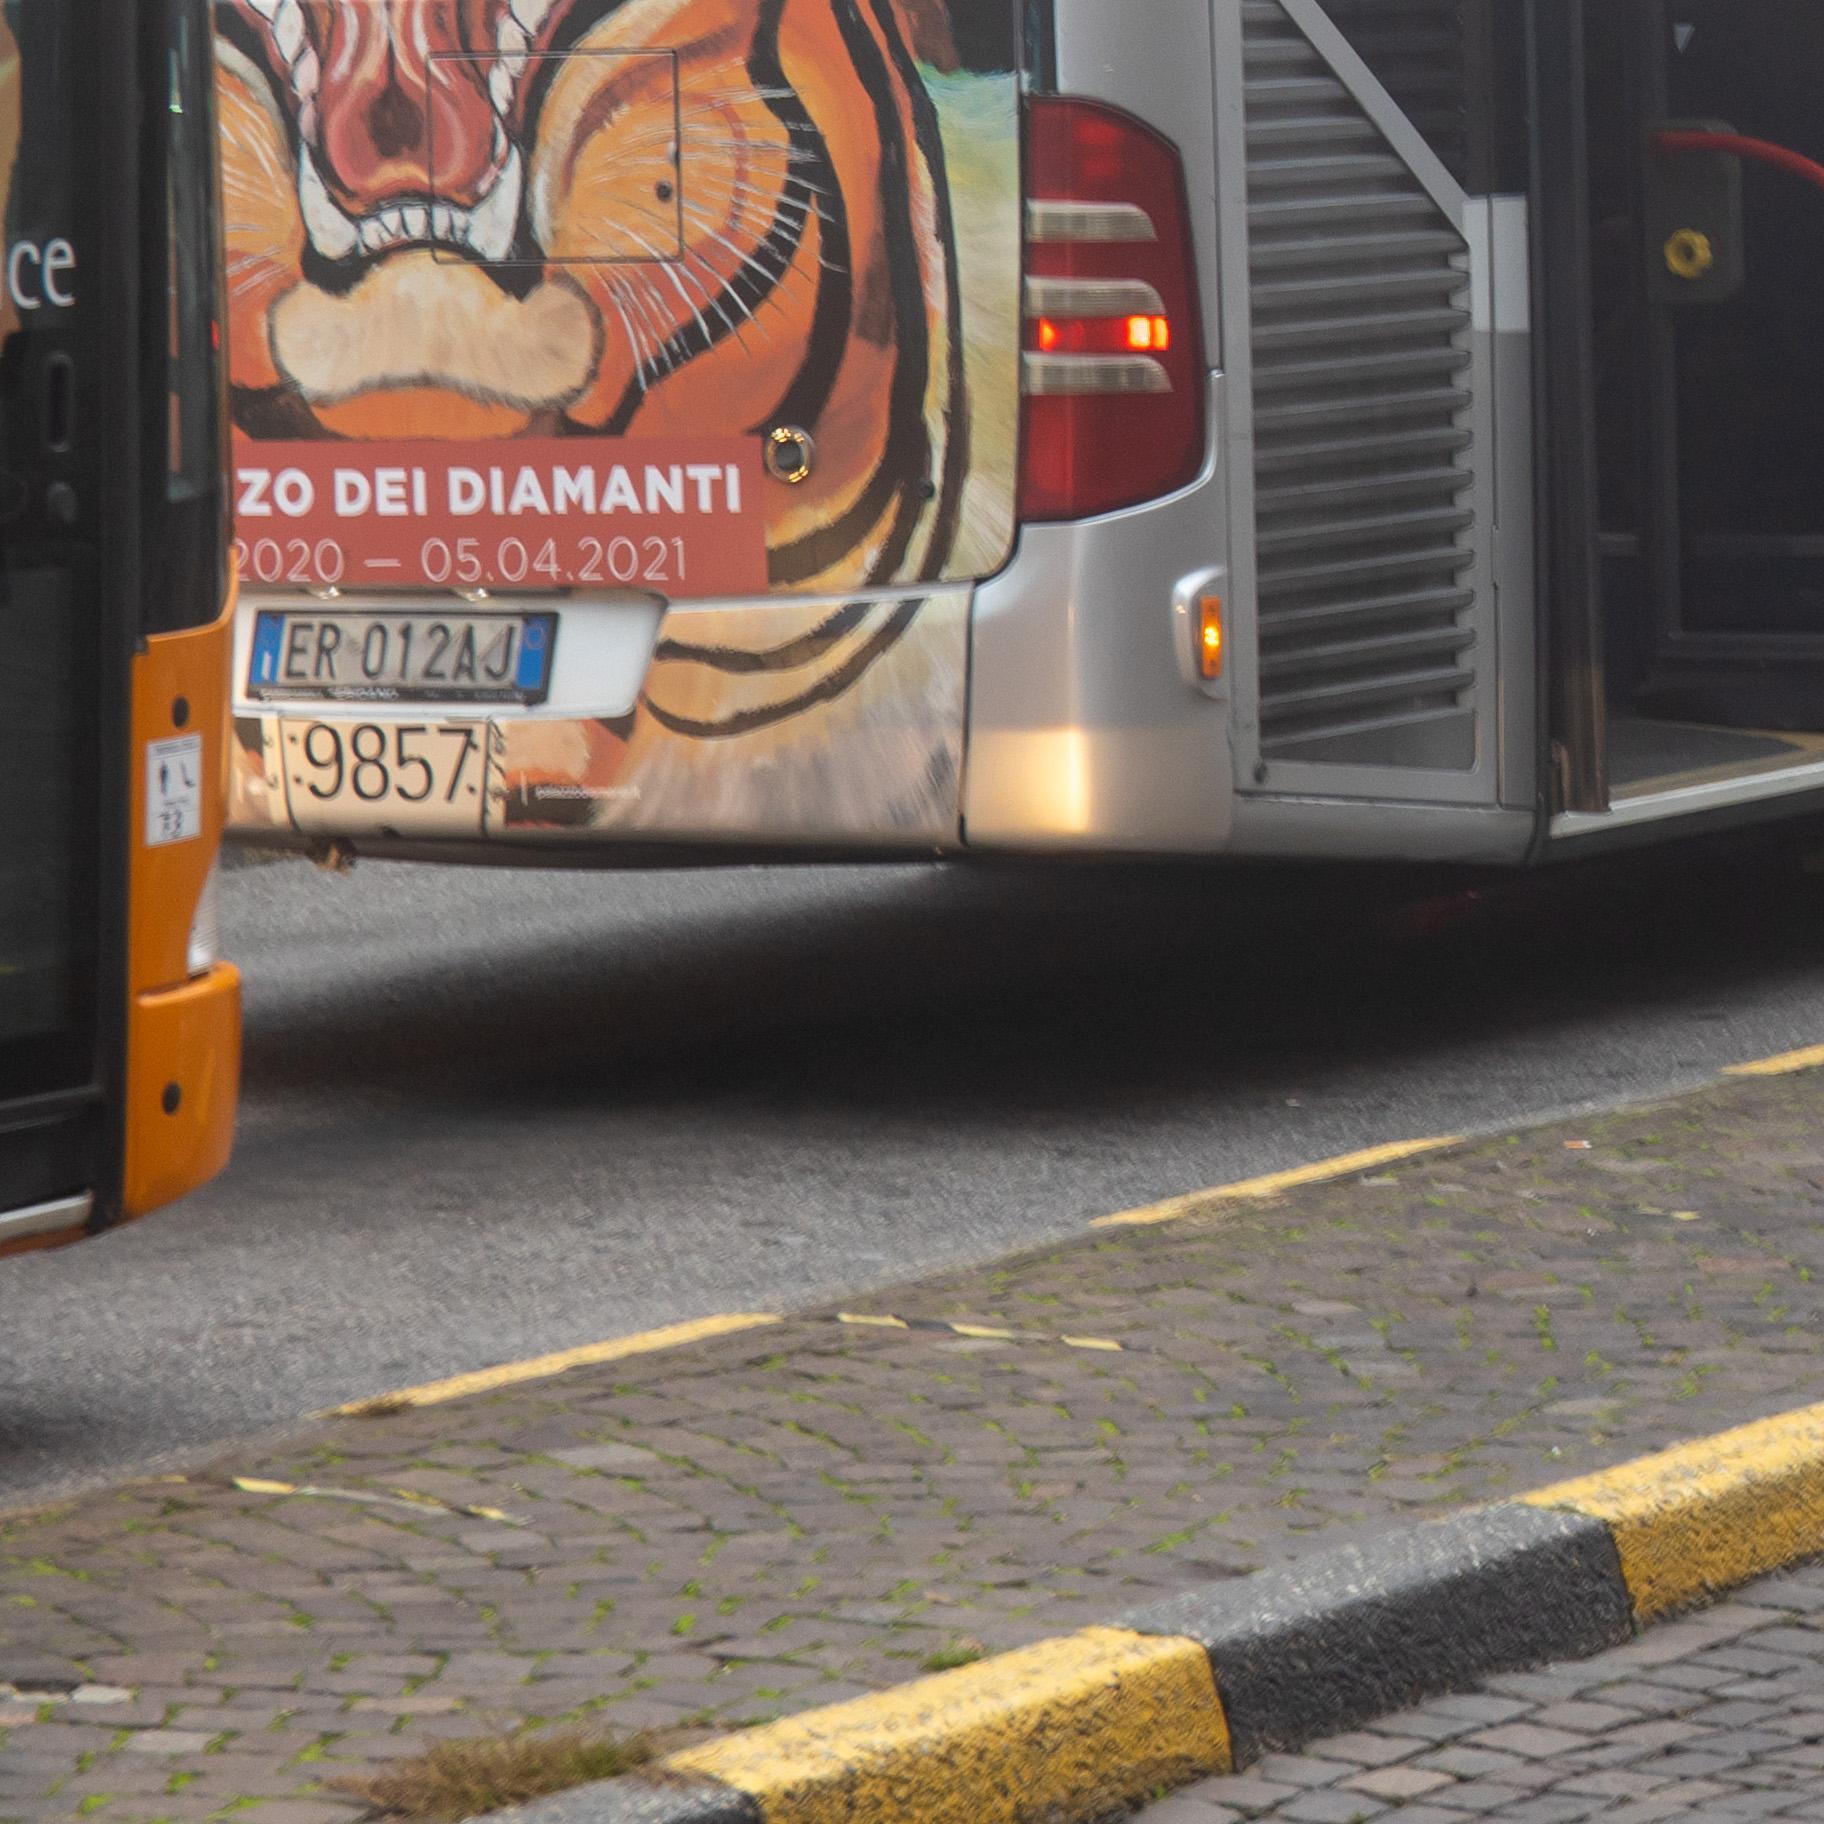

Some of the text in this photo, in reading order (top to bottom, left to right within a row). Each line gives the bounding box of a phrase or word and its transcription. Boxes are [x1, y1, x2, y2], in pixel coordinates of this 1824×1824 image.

[333, 466, 428, 516] DEI
[447, 463, 743, 516] DIAMANTI
[420, 535, 687, 583] 05.04.2021
[285, 622, 518, 682] ER 012AJ
[303, 722, 475, 803] 9857
